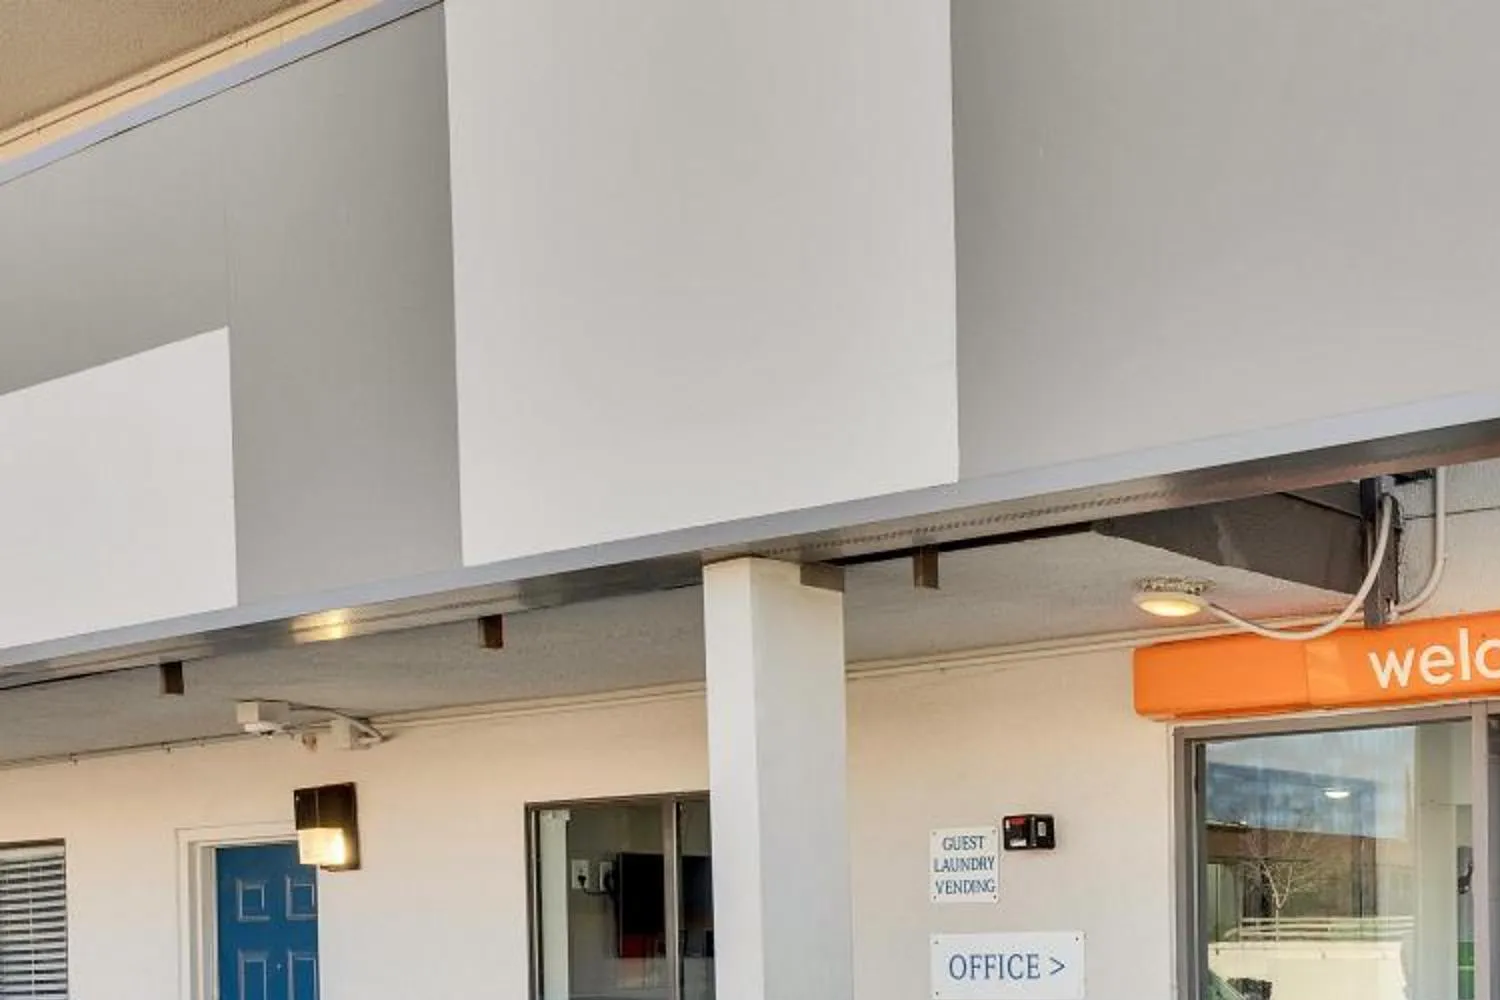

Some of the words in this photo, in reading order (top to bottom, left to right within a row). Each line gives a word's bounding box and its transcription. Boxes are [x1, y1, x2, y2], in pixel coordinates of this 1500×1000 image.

[943, 835, 985, 851] GUEST
[934, 857, 995, 873] LAUNDRY
[935, 879, 995, 895] VENDING
[949, 953, 1041, 980] OFFICE
